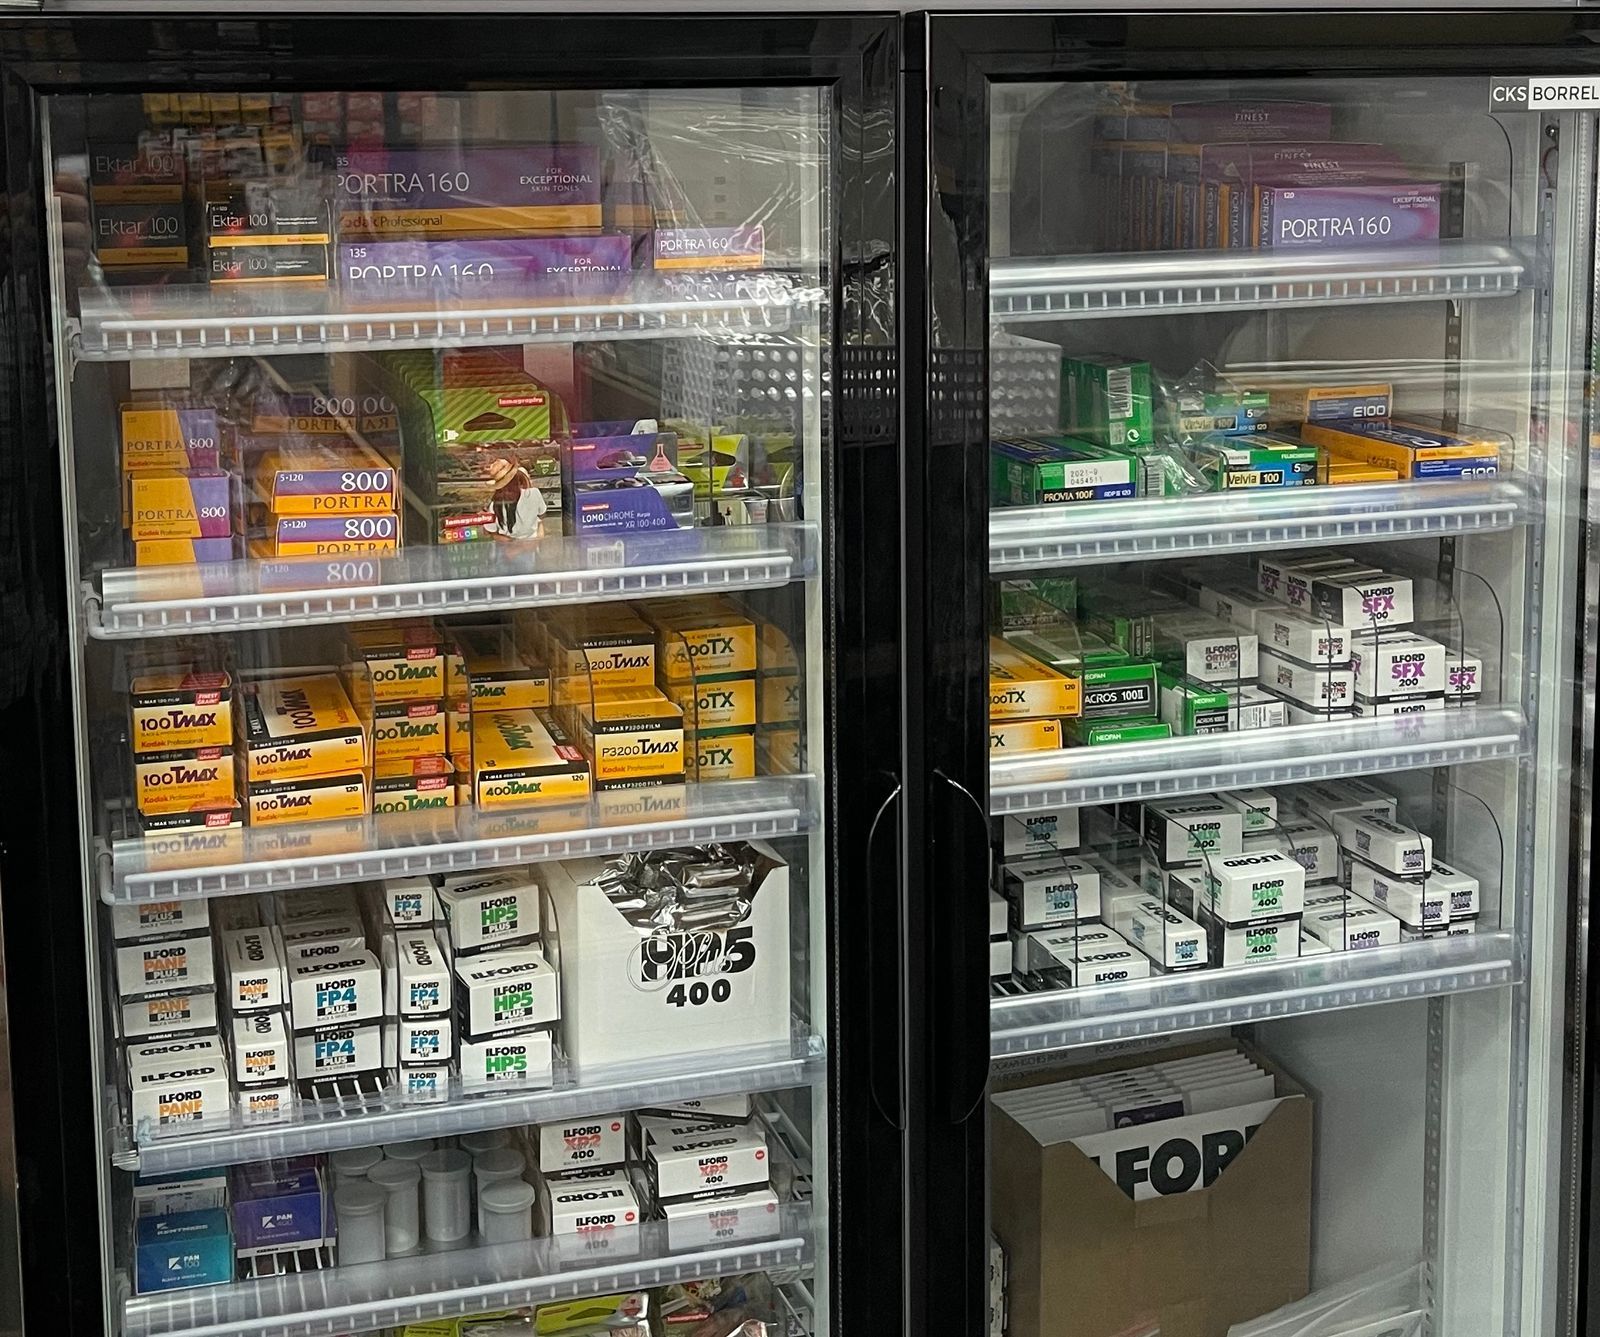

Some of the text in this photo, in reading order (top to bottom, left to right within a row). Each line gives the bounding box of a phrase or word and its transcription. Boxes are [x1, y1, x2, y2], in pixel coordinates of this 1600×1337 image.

[1493, 86, 1600, 102] CKS BORREL
[1235, 113, 1269, 121] FINEST
[95, 155, 174, 172] Ektar 100
[428, 172, 470, 192] 160
[520, 174, 593, 185] EXCEPTIONAL
[99, 217, 178, 235] Ektar 100
[212, 214, 244, 228] Ektar
[248, 213, 268, 226] 100
[380, 214, 443, 227] Professional
[1282, 216, 1391, 238] PORTRA 160
[659, 238, 728, 251] PORTRA 160
[350, 248, 366, 258] 135
[212, 259, 244, 272] Ektar
[248, 258, 267, 270] 100
[313, 397, 354, 415] 800
[1353, 405, 1386, 417] E100
[1247, 409, 1253, 418] 5
[127, 437, 214, 451] PORTRA 800
[1294, 463, 1301, 472] 5
[341, 471, 388, 491] 800
[1229, 472, 1280, 485] Velvia 100
[1044, 489, 1094, 502] PROVIA 100F
[313, 496, 388, 510] PORTRA
[137, 506, 226, 520] PORTRA 800
[582, 511, 635, 523] LOMOCHROME
[445, 514, 493, 526] lomography
[344, 518, 392, 538] 800
[446, 528, 477, 540] COLOR
[326, 561, 373, 582] 800
[1362, 595, 1394, 613] SFX
[1369, 611, 1388, 620] 200
[1206, 653, 1237, 662] ORTHO
[1392, 653, 1425, 664] ILFORD
[1391, 662, 1425, 679] SFX
[1400, 678, 1418, 687] 200
[1084, 693, 1117, 704] ACROS
[141, 740, 166, 748] Kodak
[602, 764, 664, 774] Kodak Professional
[143, 795, 168, 804] Kodak
[1045, 883, 1078, 894] ILFORD
[1252, 880, 1284, 891] ILFORD
[1252, 888, 1284, 900] DELTA
[394, 900, 422, 911] FP4
[481, 896, 517, 911] ILFORD
[1053, 901, 1070, 910] 100
[1257, 898, 1278, 907] 400
[149, 911, 174, 922] PLUS
[481, 907, 518, 926] HP5
[489, 922, 511, 933] PLUS
[1246, 927, 1278, 938] ILFORD
[1246, 935, 1278, 947] DELTA
[1349, 930, 1380, 942] ILFORD
[143, 947, 186, 960] ILFORD
[301, 946, 340, 958] ILFORD
[641, 926, 756, 982] HP5
[1251, 944, 1272, 954] 400
[1069, 951, 1131, 964] ILFORD
[297, 958, 366, 975] ILFORD
[470, 962, 539, 980] ILFORD
[153, 969, 179, 980] PLUS
[1095, 971, 1128, 982] ILFORD
[239, 978, 268, 987] ILFORD
[316, 979, 356, 992] ILFORD
[410, 989, 439, 1001] FP4
[494, 982, 532, 996] ILFORD
[666, 978, 731, 1007] 400
[316, 988, 357, 1008] FP4
[494, 991, 533, 1013] HP5
[324, 1004, 350, 1015] PLUS
[502, 1008, 525, 1020] PLUS
[157, 1011, 183, 1021] PLUS
[315, 1030, 354, 1043] ILFORD
[411, 1029, 439, 1037] ILFORD
[410, 1036, 439, 1047] FP4
[245, 1049, 275, 1059] ILFORD
[315, 1039, 355, 1059] FP4
[486, 1046, 526, 1057] ILFORD
[323, 1056, 348, 1066] PLUS
[486, 1055, 527, 1072] HP5
[141, 1067, 215, 1082] ILFORD
[408, 1072, 437, 1080] ILFORD
[408, 1079, 437, 1092] FP4
[158, 1090, 202, 1104] ILFORD
[250, 1093, 279, 1102] ILFORD
[563, 1125, 601, 1137] ILFORD
[672, 1138, 738, 1152] ILFORD
[571, 1149, 595, 1160] 400
[699, 1156, 728, 1166] ILFORD
[1091, 1124, 1263, 1201] FOR
[705, 1175, 723, 1184] 400
[557, 1189, 624, 1203] ILFORD
[277, 1213, 293, 1221] PAN
[576, 1214, 615, 1227] ILFORD
[157, 1223, 208, 1236] KENTMERE
[716, 1228, 734, 1237] 400
[584, 1238, 609, 1250] 400
